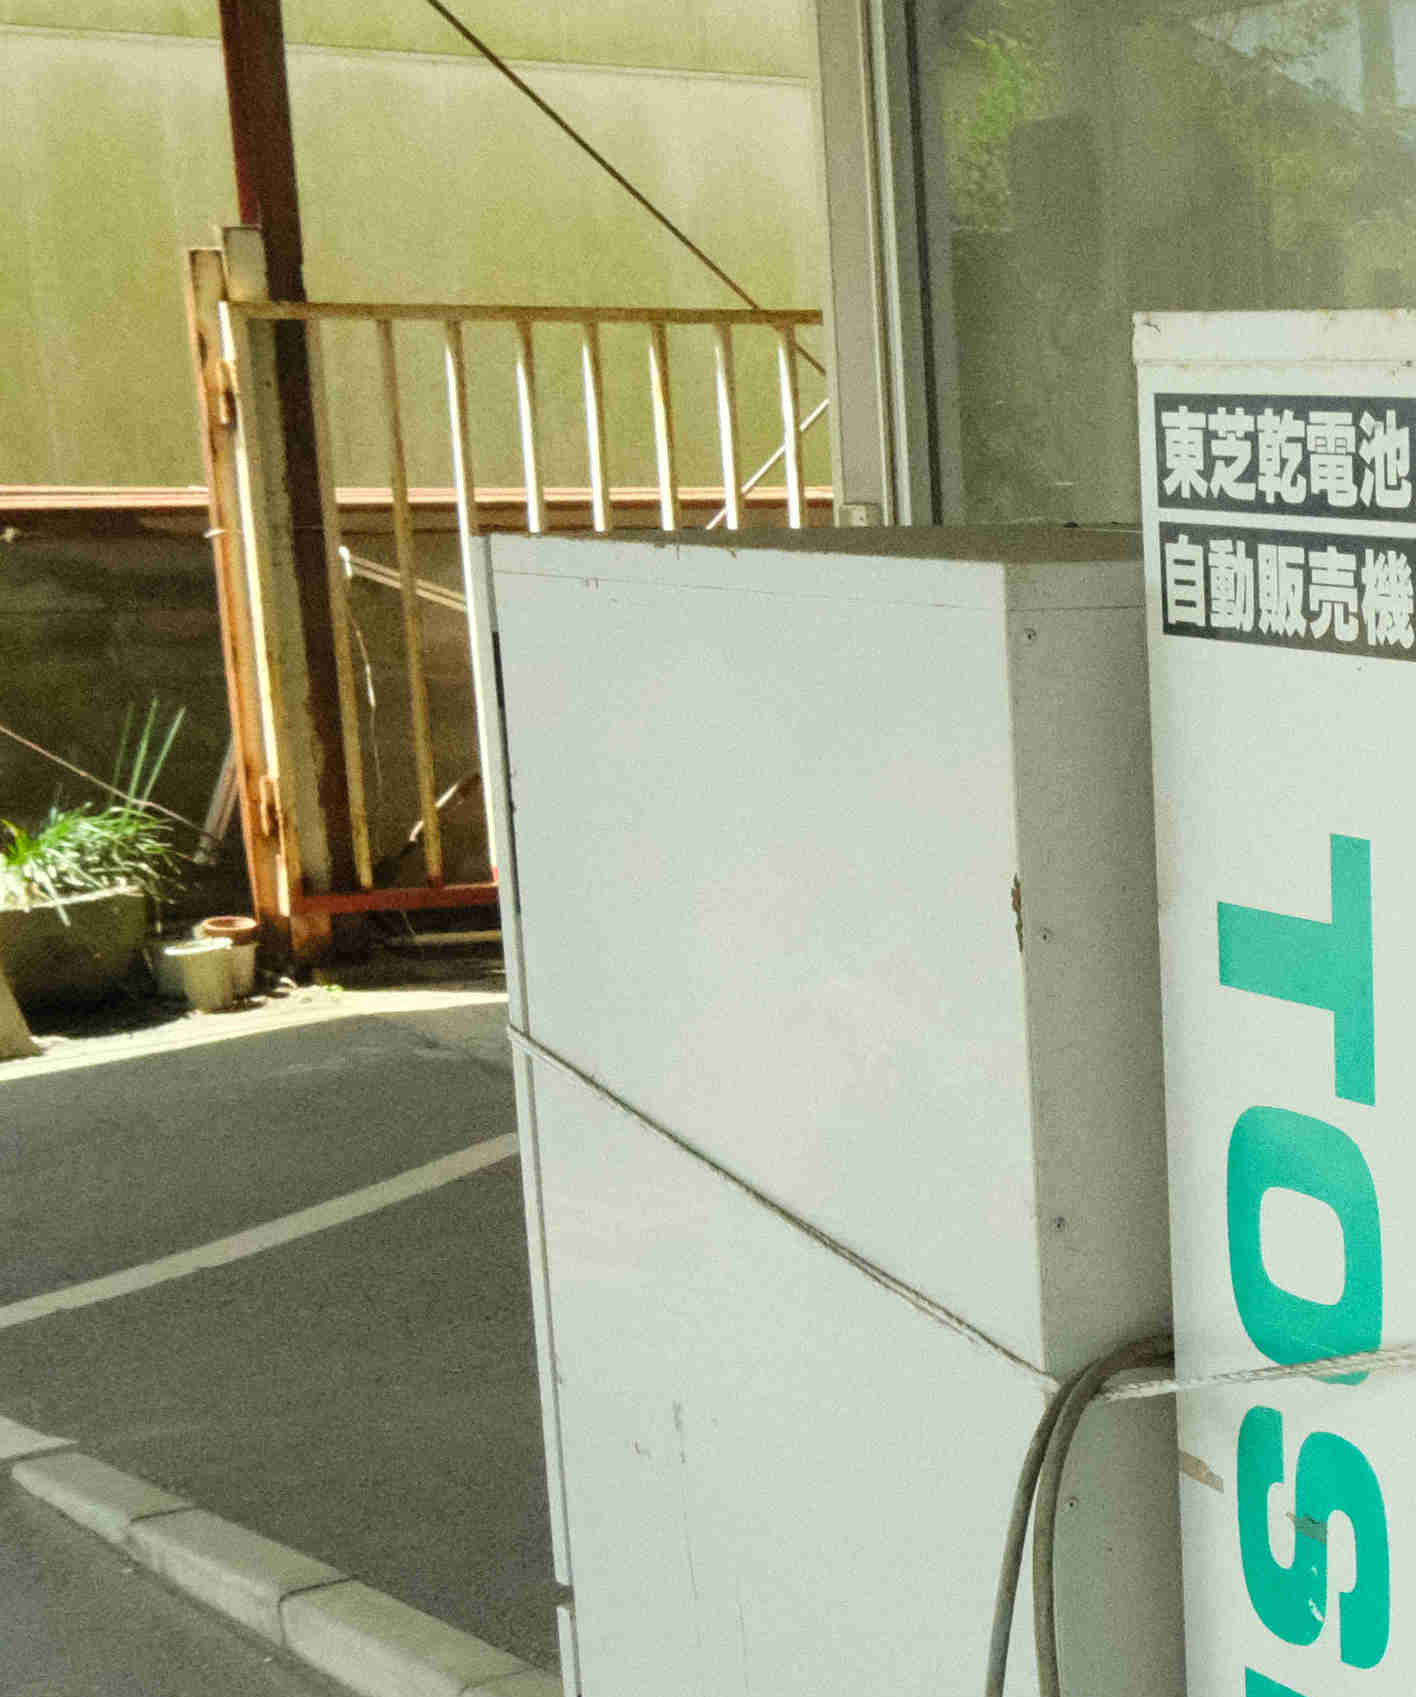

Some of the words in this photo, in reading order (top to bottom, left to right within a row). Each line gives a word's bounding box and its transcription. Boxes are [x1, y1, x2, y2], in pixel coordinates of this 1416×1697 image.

[1161, 405, 1412, 508] 東芝乾電池
[1164, 534, 1415, 649] 自動販売機
